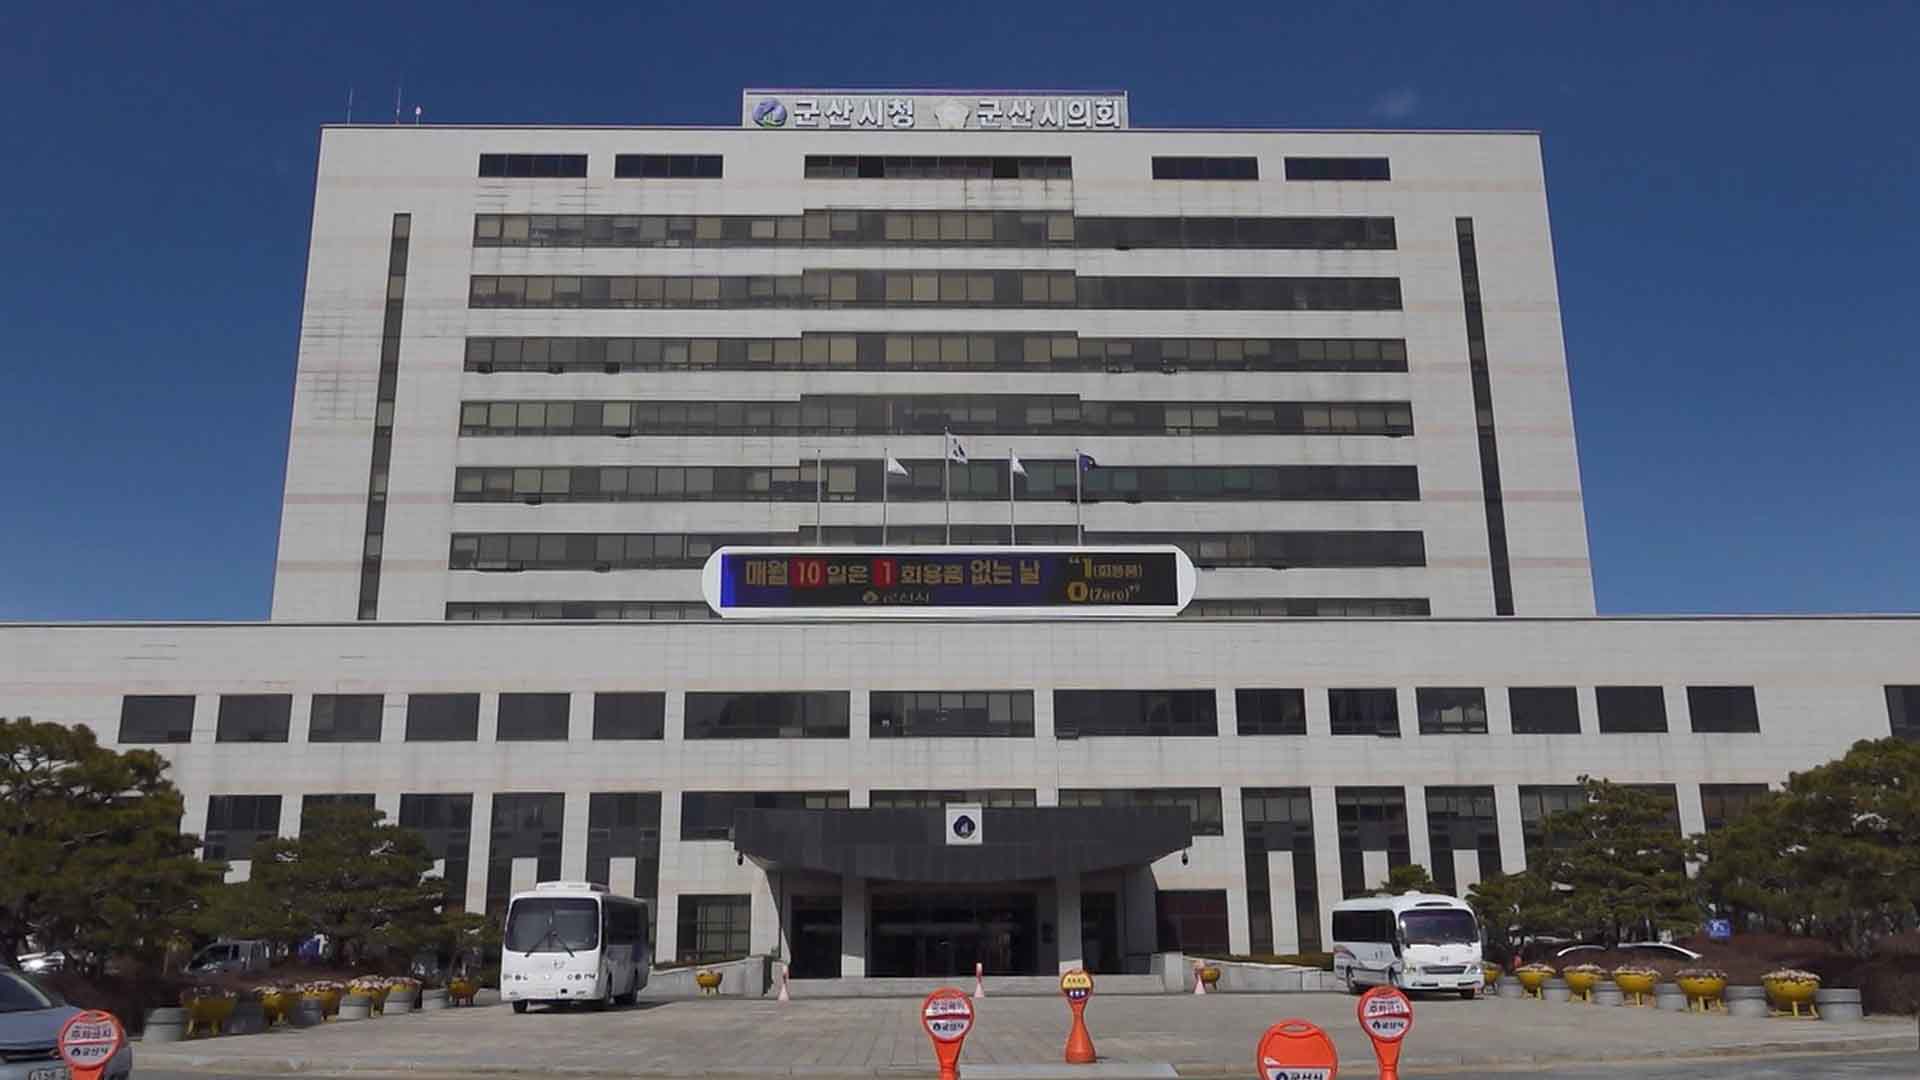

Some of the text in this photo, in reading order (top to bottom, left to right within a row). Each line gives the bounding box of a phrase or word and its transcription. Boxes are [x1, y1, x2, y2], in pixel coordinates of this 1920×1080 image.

[794, 98, 914, 127] 군산시청
[977, 98, 1121, 128] 군산시의회
[745, 560, 788, 586] 매월
[971, 560, 1012, 585] 없는
[1019, 560, 1040, 585] 날
